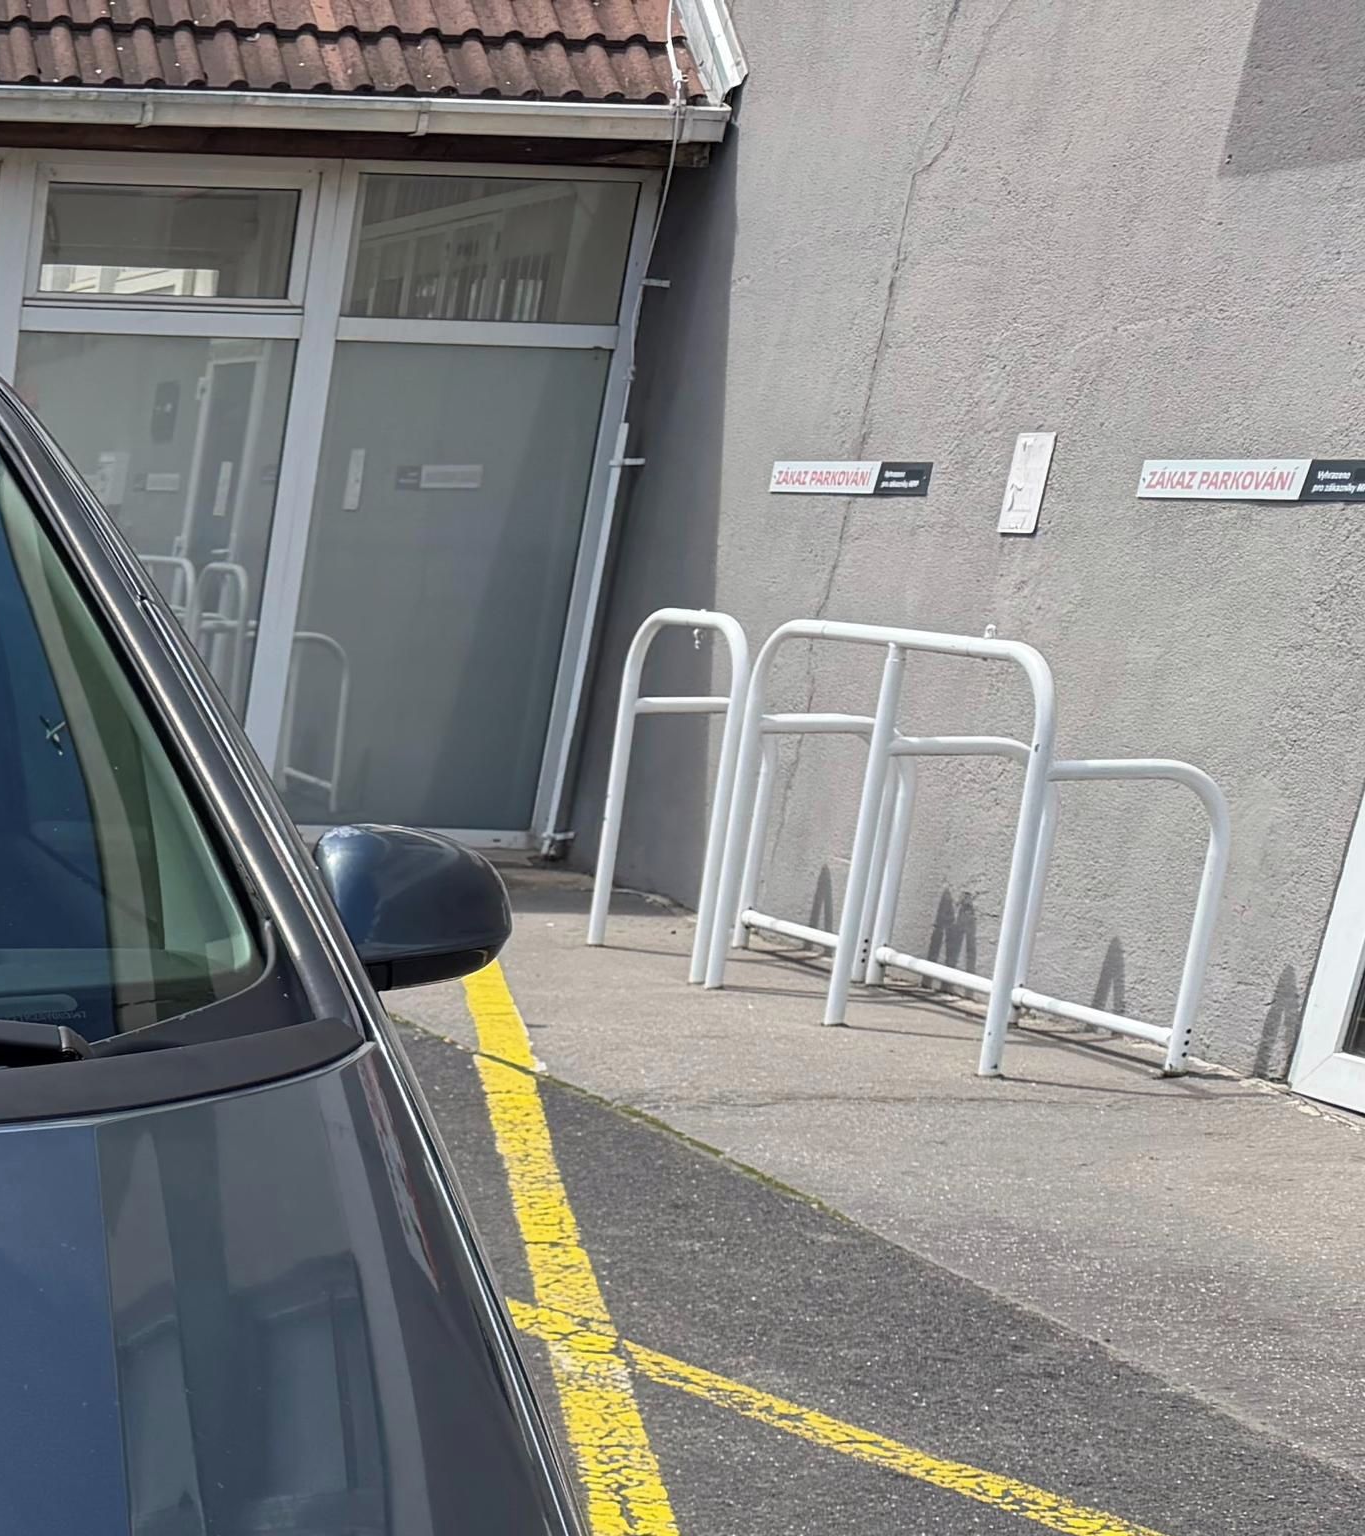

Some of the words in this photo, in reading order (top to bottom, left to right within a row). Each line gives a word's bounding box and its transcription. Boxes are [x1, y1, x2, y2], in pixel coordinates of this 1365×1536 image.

[775, 467, 809, 486] ZÁKAZ
[809, 467, 873, 487] PARKOVÁNÍ
[1145, 466, 1197, 490] ZÁKAZ
[1197, 466, 1299, 491] PARKOVÁNÍ
